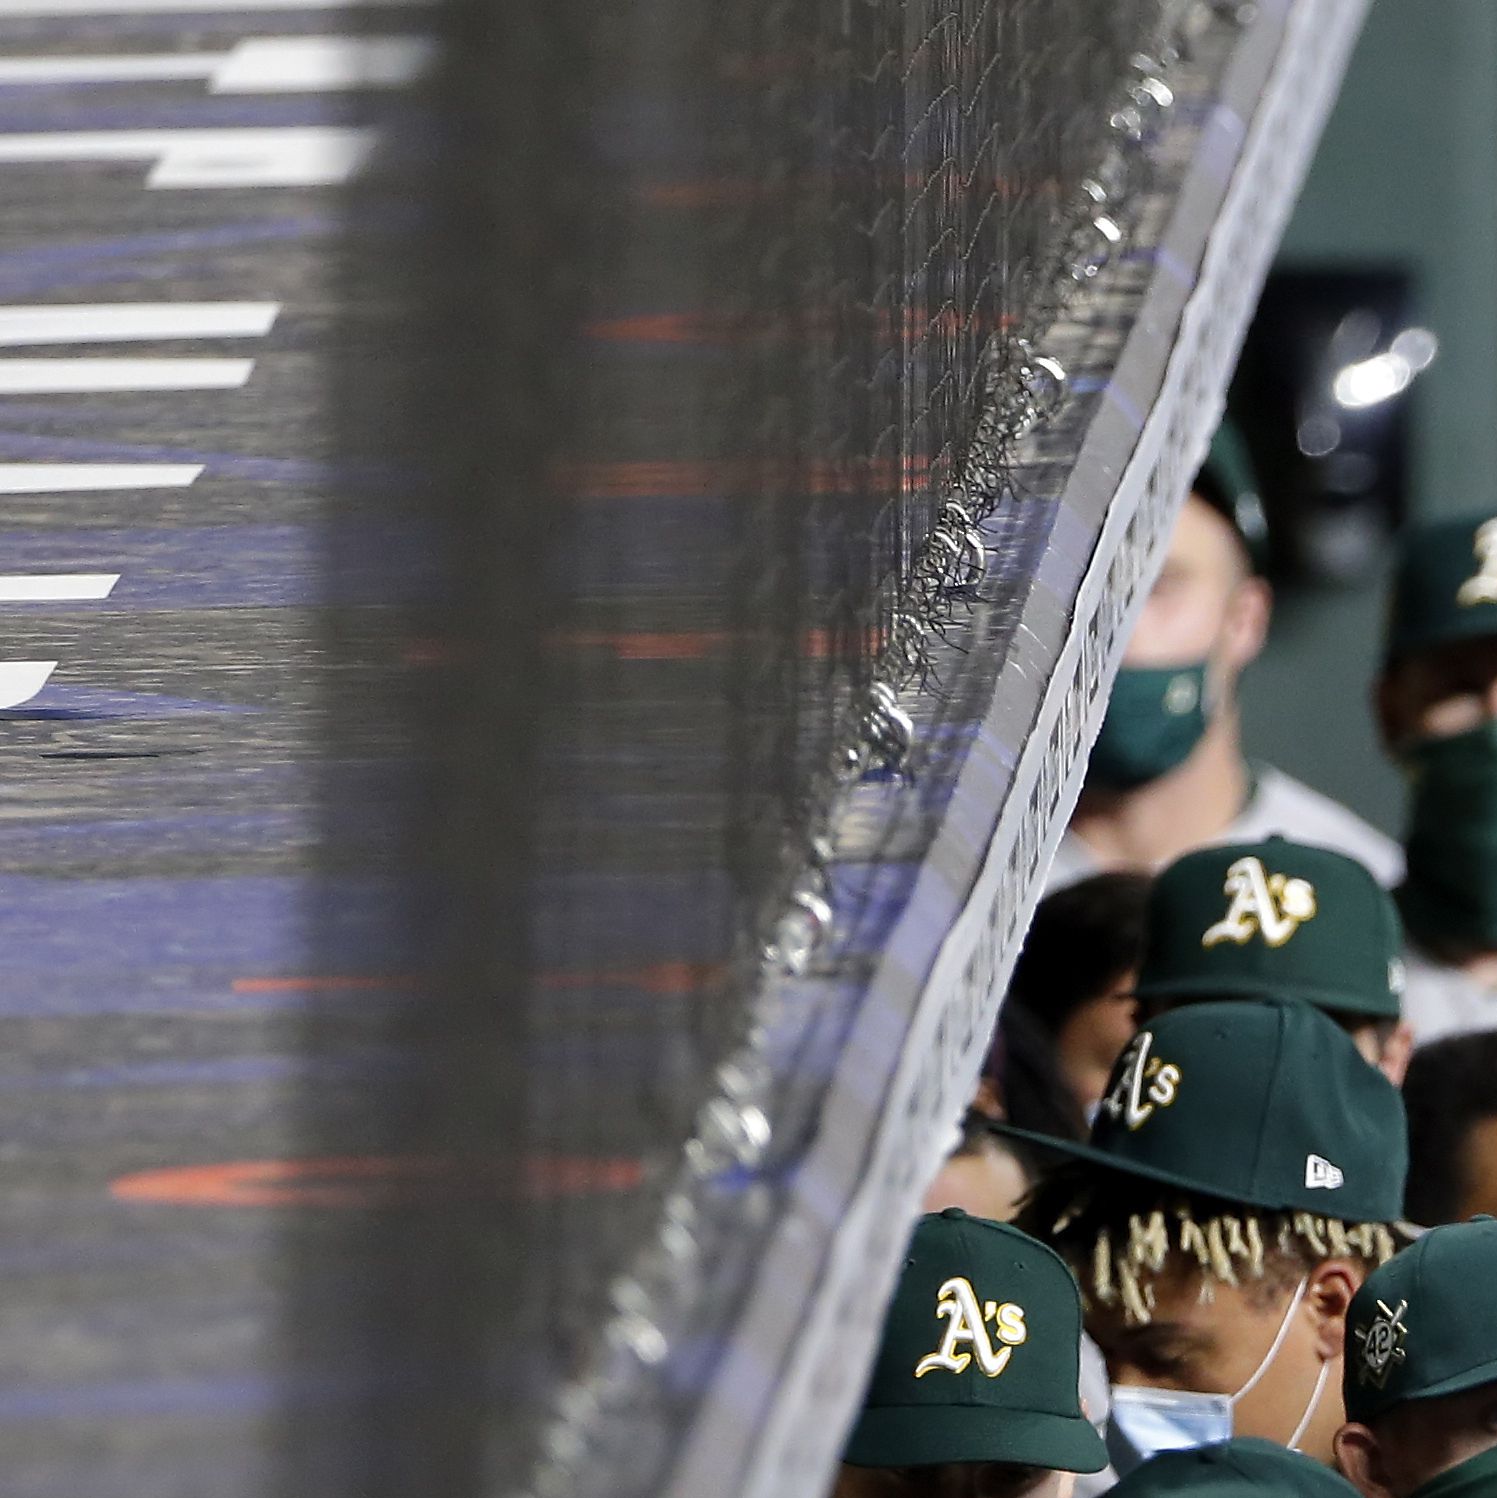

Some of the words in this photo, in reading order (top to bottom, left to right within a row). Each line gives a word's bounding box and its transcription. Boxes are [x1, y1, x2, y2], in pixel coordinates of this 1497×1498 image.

[1201, 855, 1316, 947] A's
[1102, 1031, 1182, 1131] A's
[914, 1275, 1028, 1378] A's
